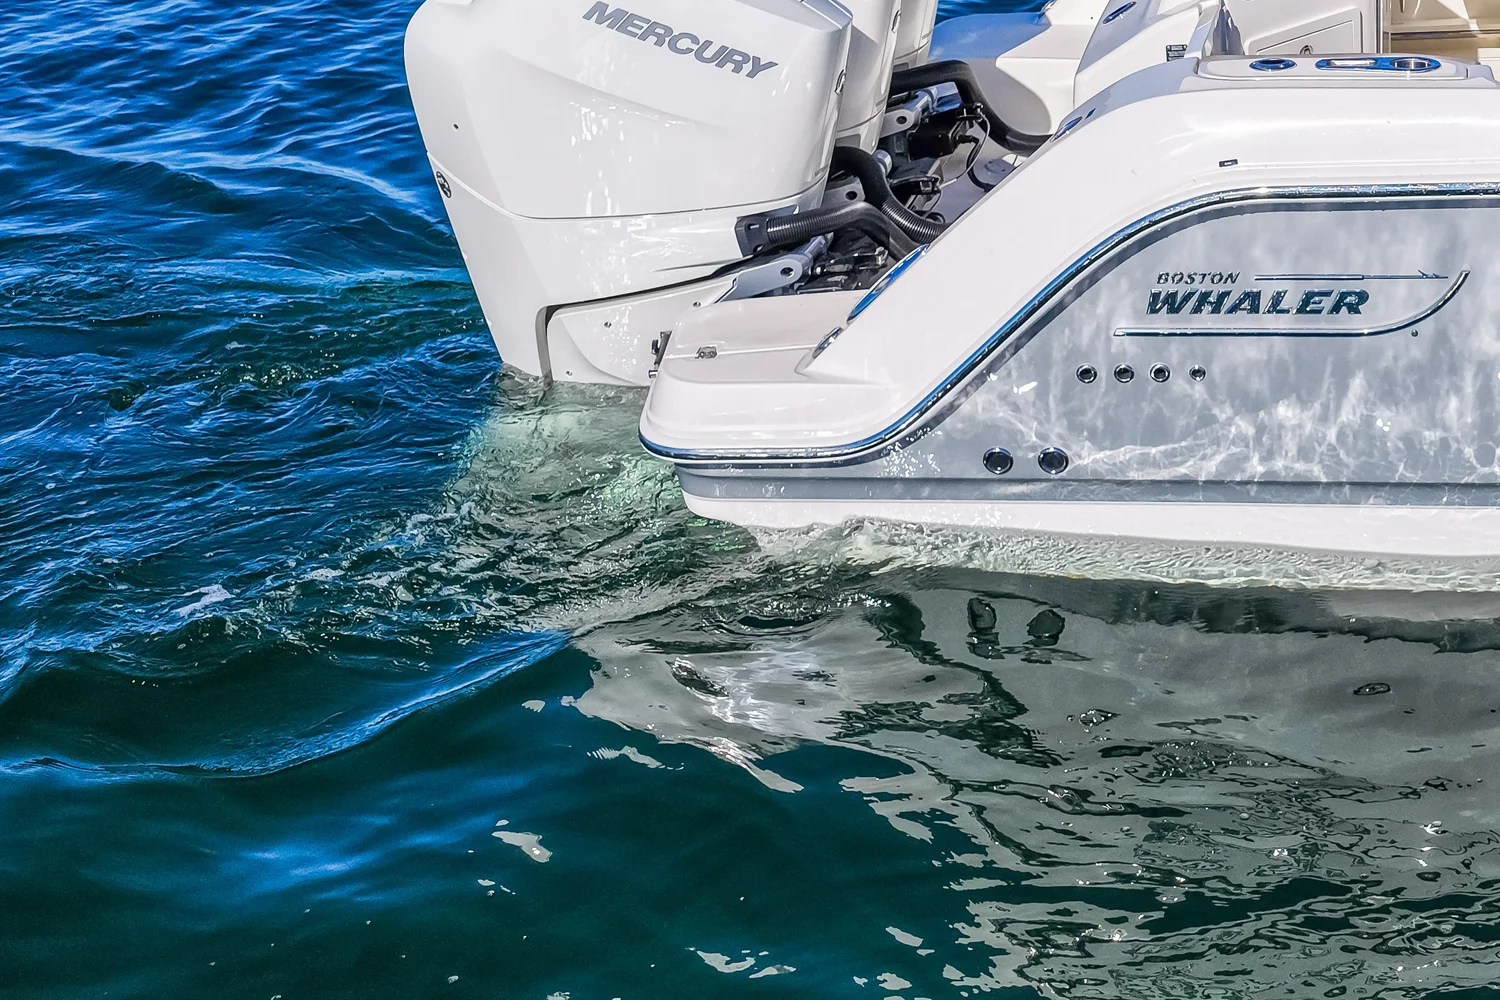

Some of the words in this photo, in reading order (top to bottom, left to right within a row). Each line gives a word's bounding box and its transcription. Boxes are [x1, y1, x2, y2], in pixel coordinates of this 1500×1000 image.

[582, 0, 779, 79] MERCURY
[1156, 271, 1241, 285] BOSTON
[1146, 288, 1370, 315] WHALER
